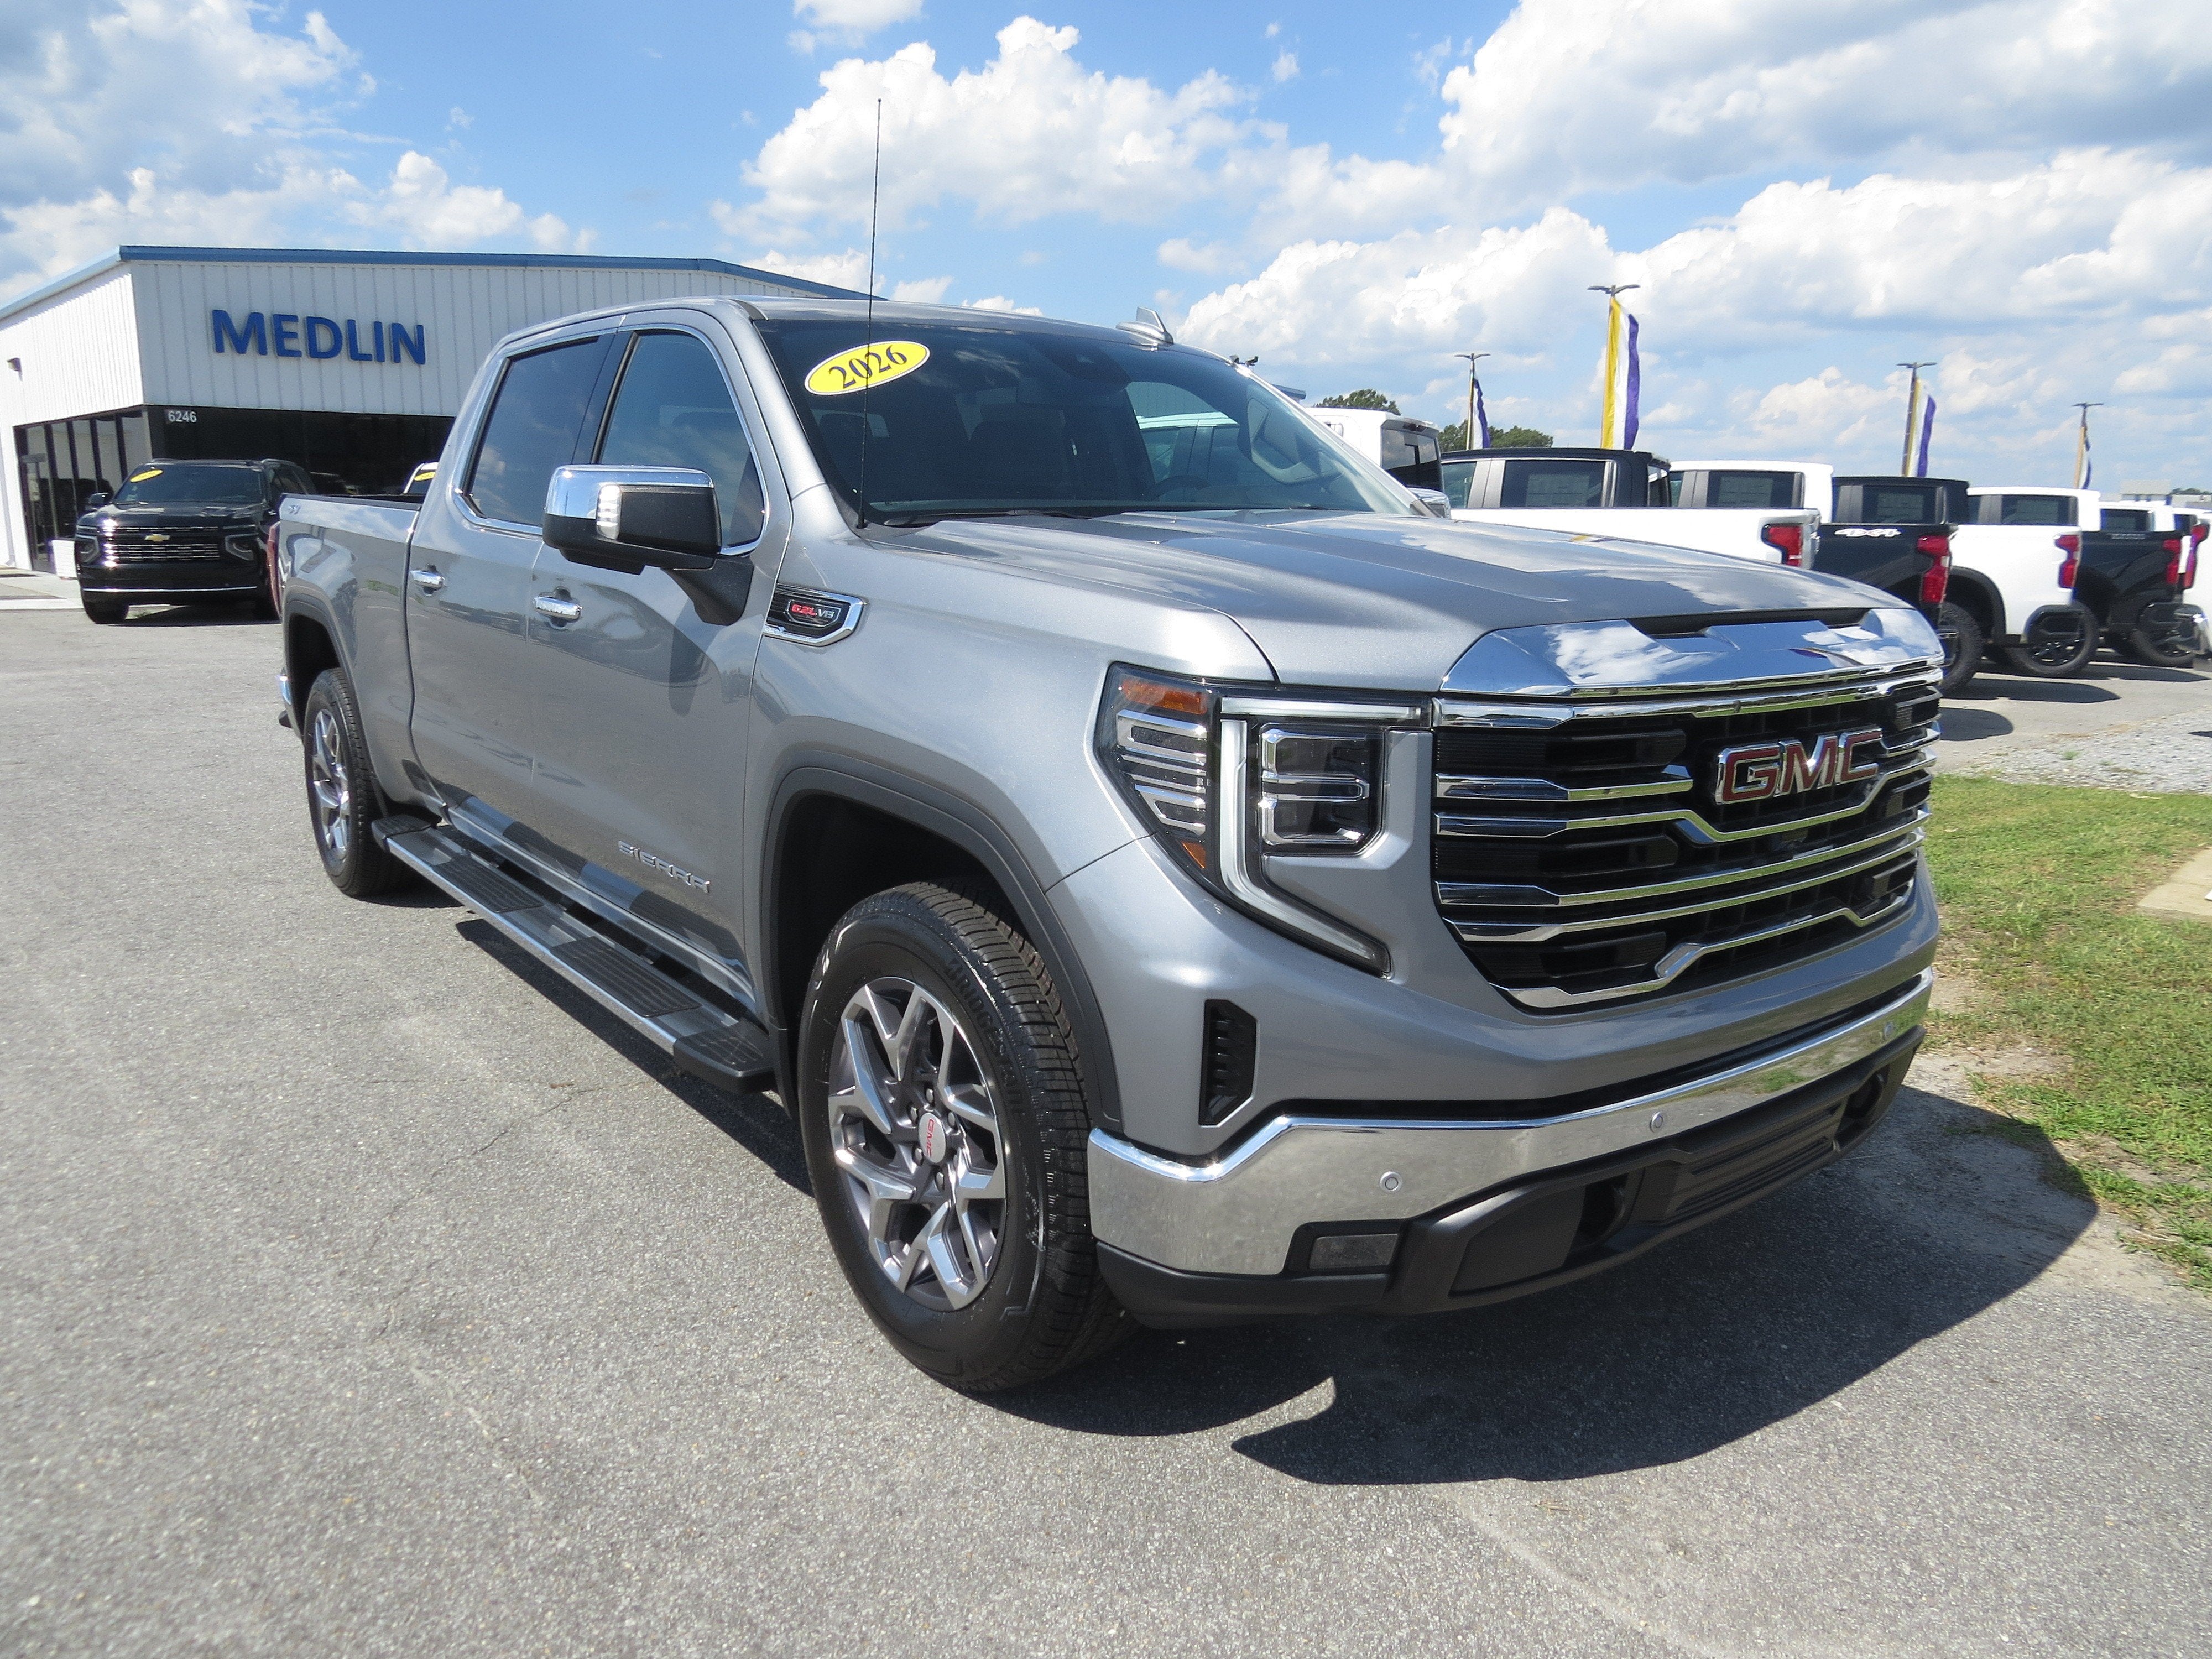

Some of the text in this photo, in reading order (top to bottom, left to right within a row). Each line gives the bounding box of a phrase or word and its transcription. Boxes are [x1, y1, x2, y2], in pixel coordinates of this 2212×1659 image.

[212, 310, 426, 365] MEDLIN
[829, 345, 907, 389] 2026
[168, 410, 197, 423] 6246
[1715, 727, 1882, 805] GMC
[618, 841, 711, 893] SIERRA
[926, 1118, 935, 1158] GMC
